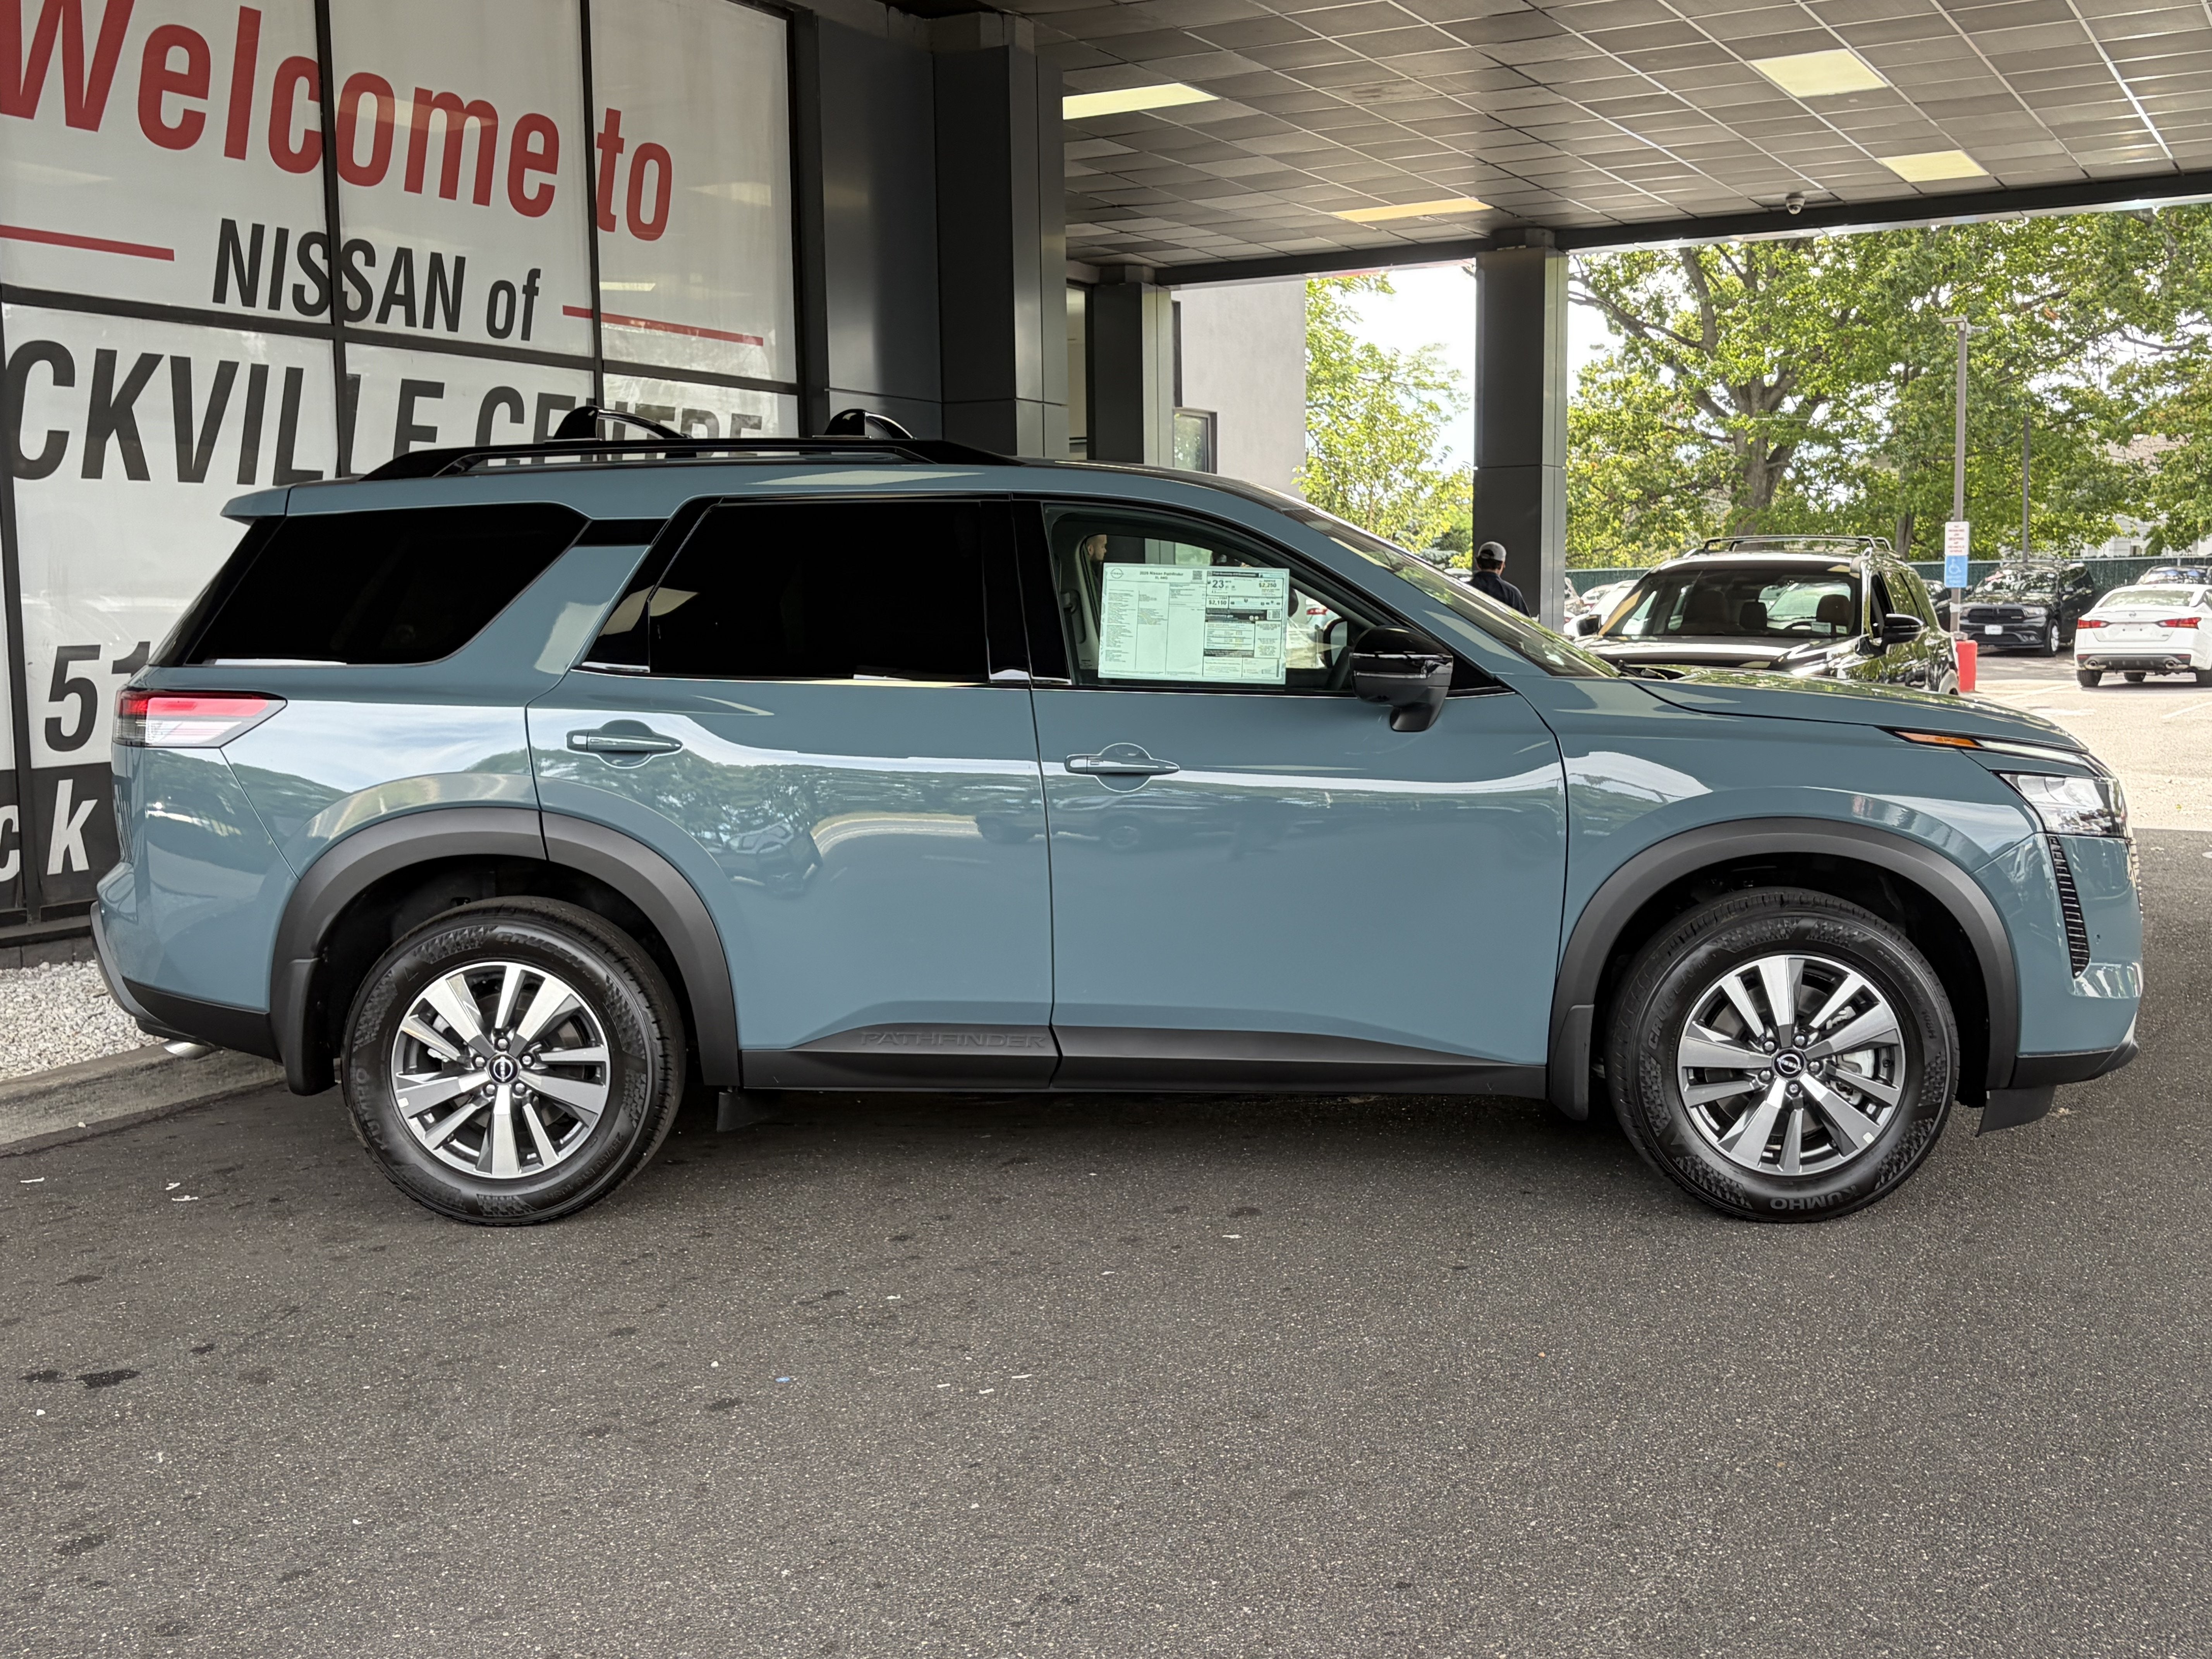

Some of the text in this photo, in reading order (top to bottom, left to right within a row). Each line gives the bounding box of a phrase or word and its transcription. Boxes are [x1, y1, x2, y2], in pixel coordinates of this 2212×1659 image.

[0, 0, 672, 241] Welcome to
[213, 218, 541, 342] NISSAN of
[1212, 580, 1224, 588] 23
[496, 931, 586, 968] CRUGEN
[860, 1031, 1046, 1048] PATHFINDER
[356, 1068, 387, 1150] KUMHO
[1770, 1185, 1858, 1210] KUMHO
